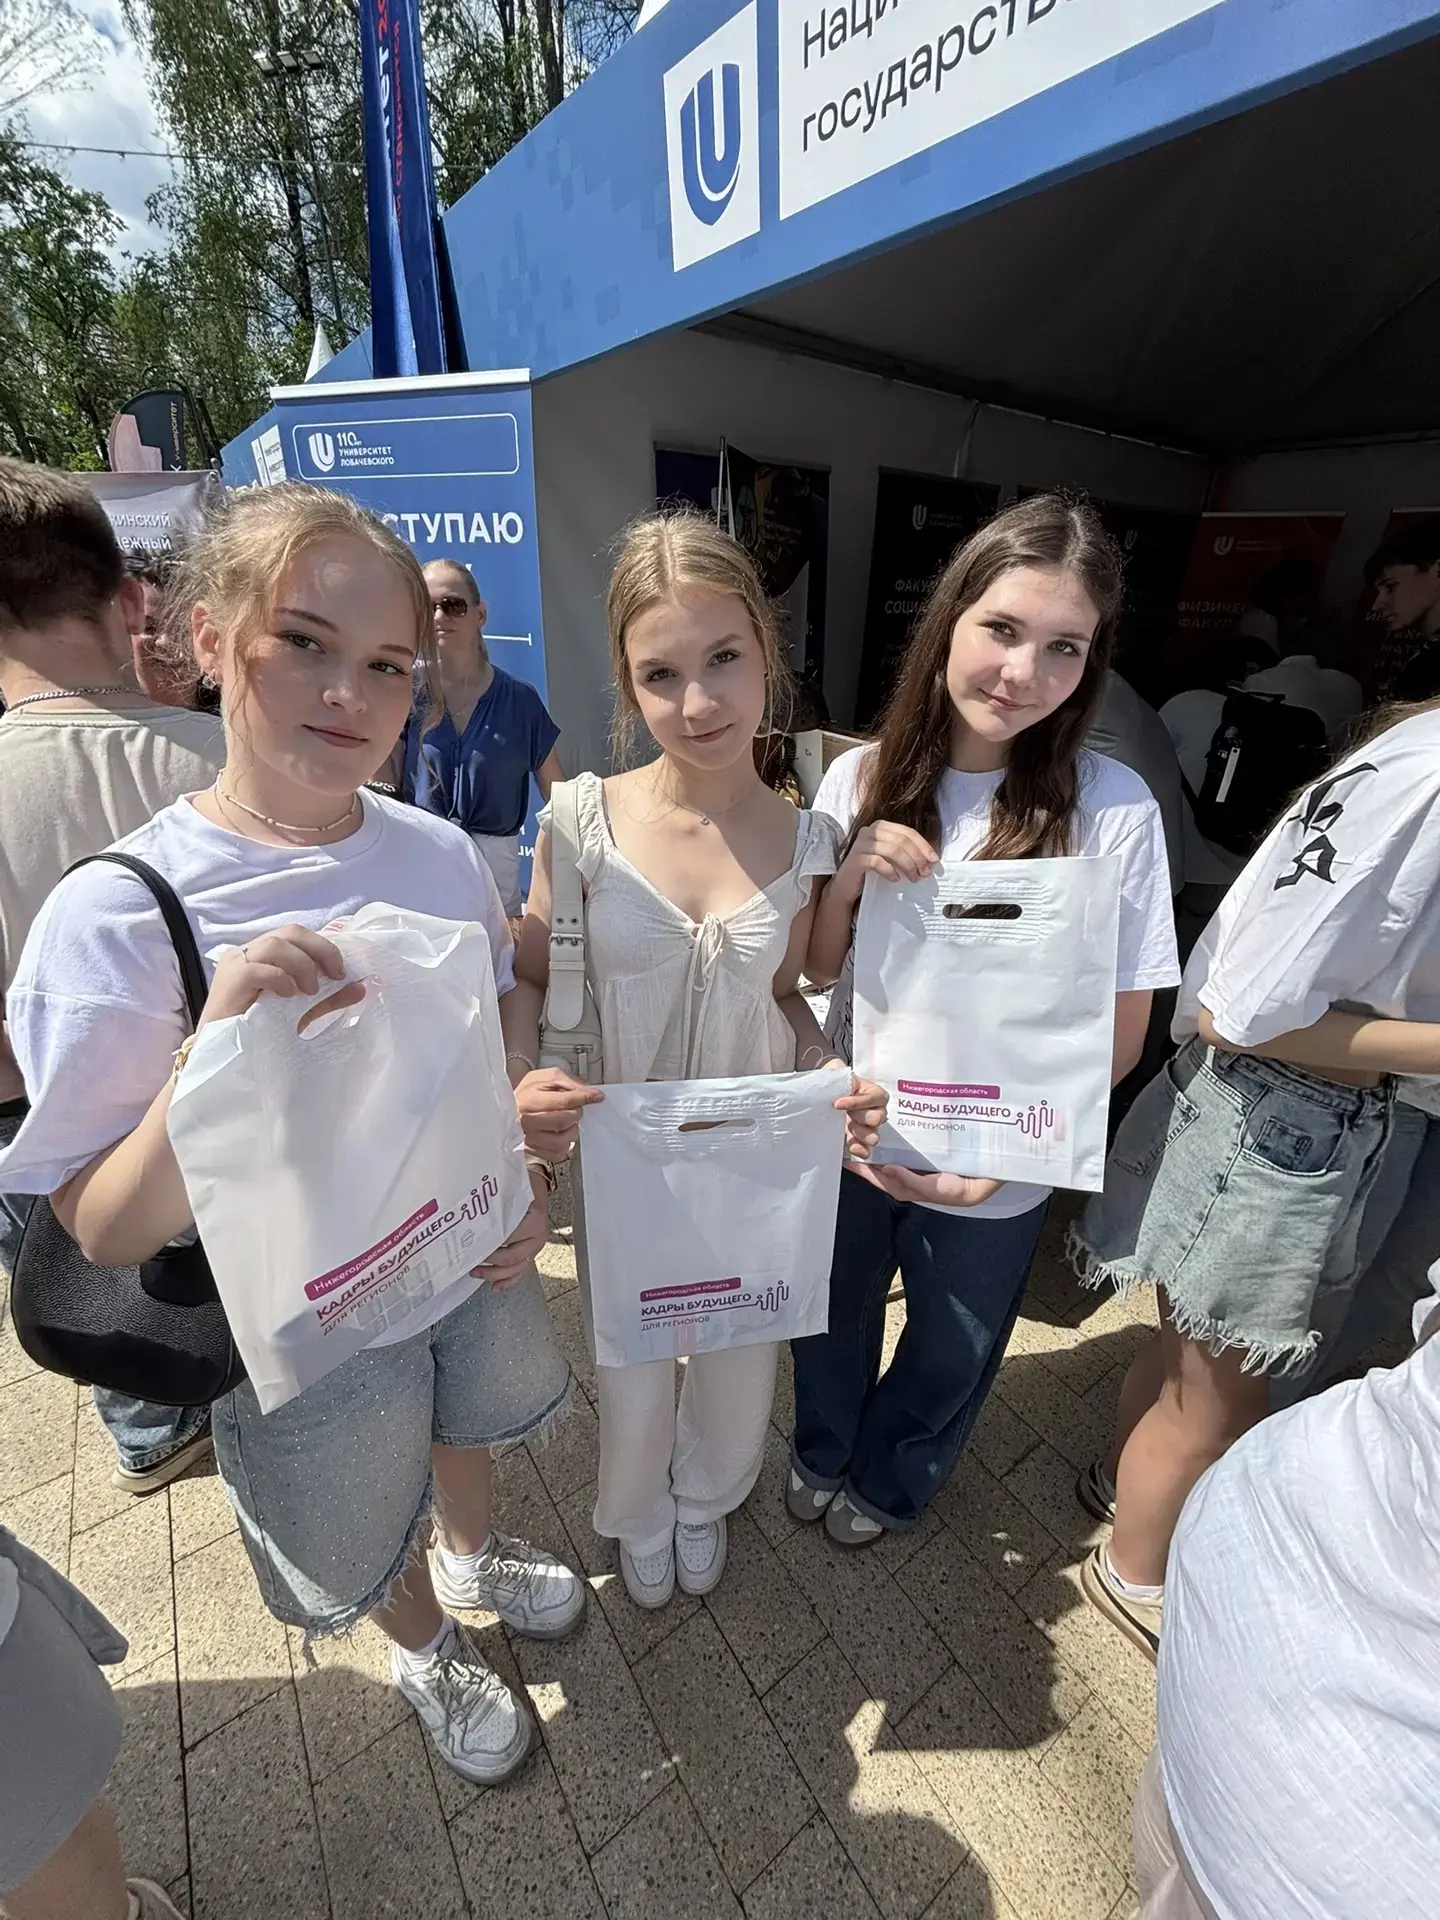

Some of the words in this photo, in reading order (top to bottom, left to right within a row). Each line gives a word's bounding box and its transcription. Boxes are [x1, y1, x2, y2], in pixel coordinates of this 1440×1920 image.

[336, 431, 357, 447] 110
[338, 446, 392, 457] УНИВЕРСИТЕТ
[340, 456, 395, 467] ЛОБАЧЕВСКОГО
[109, 510, 172, 528] кинский
[381, 511, 524, 544] СТУПАЮ
[116, 532, 173, 551] ежный
[902, 1083, 958, 1095] Нижегородская
[959, 1087, 989, 1096] область
[898, 1098, 940, 1113] КАДРЫ
[943, 1104, 1011, 1118] БУДУЩЕГО
[897, 1118, 916, 1128] ДЛЯ
[917, 1120, 966, 1132] РЕГИОНОВ
[313, 1237, 393, 1293] Нижегородская
[393, 1212, 425, 1242] область
[316, 1271, 375, 1321] КАДРЫ
[378, 1211, 455, 1276] БУДУЩЕГО
[645, 1286, 701, 1298] Нижегородская
[702, 1282, 730, 1291] область
[323, 1311, 350, 1337] ДЛЯ
[350, 1265, 411, 1315] РЕГИОНОВ
[641, 1303, 685, 1316] КАДРЫ
[687, 1293, 752, 1310] БУДУЩЕГО
[641, 1322, 661, 1332] ДЛЯ
[662, 1316, 710, 1328] РЕГИОНОВ
